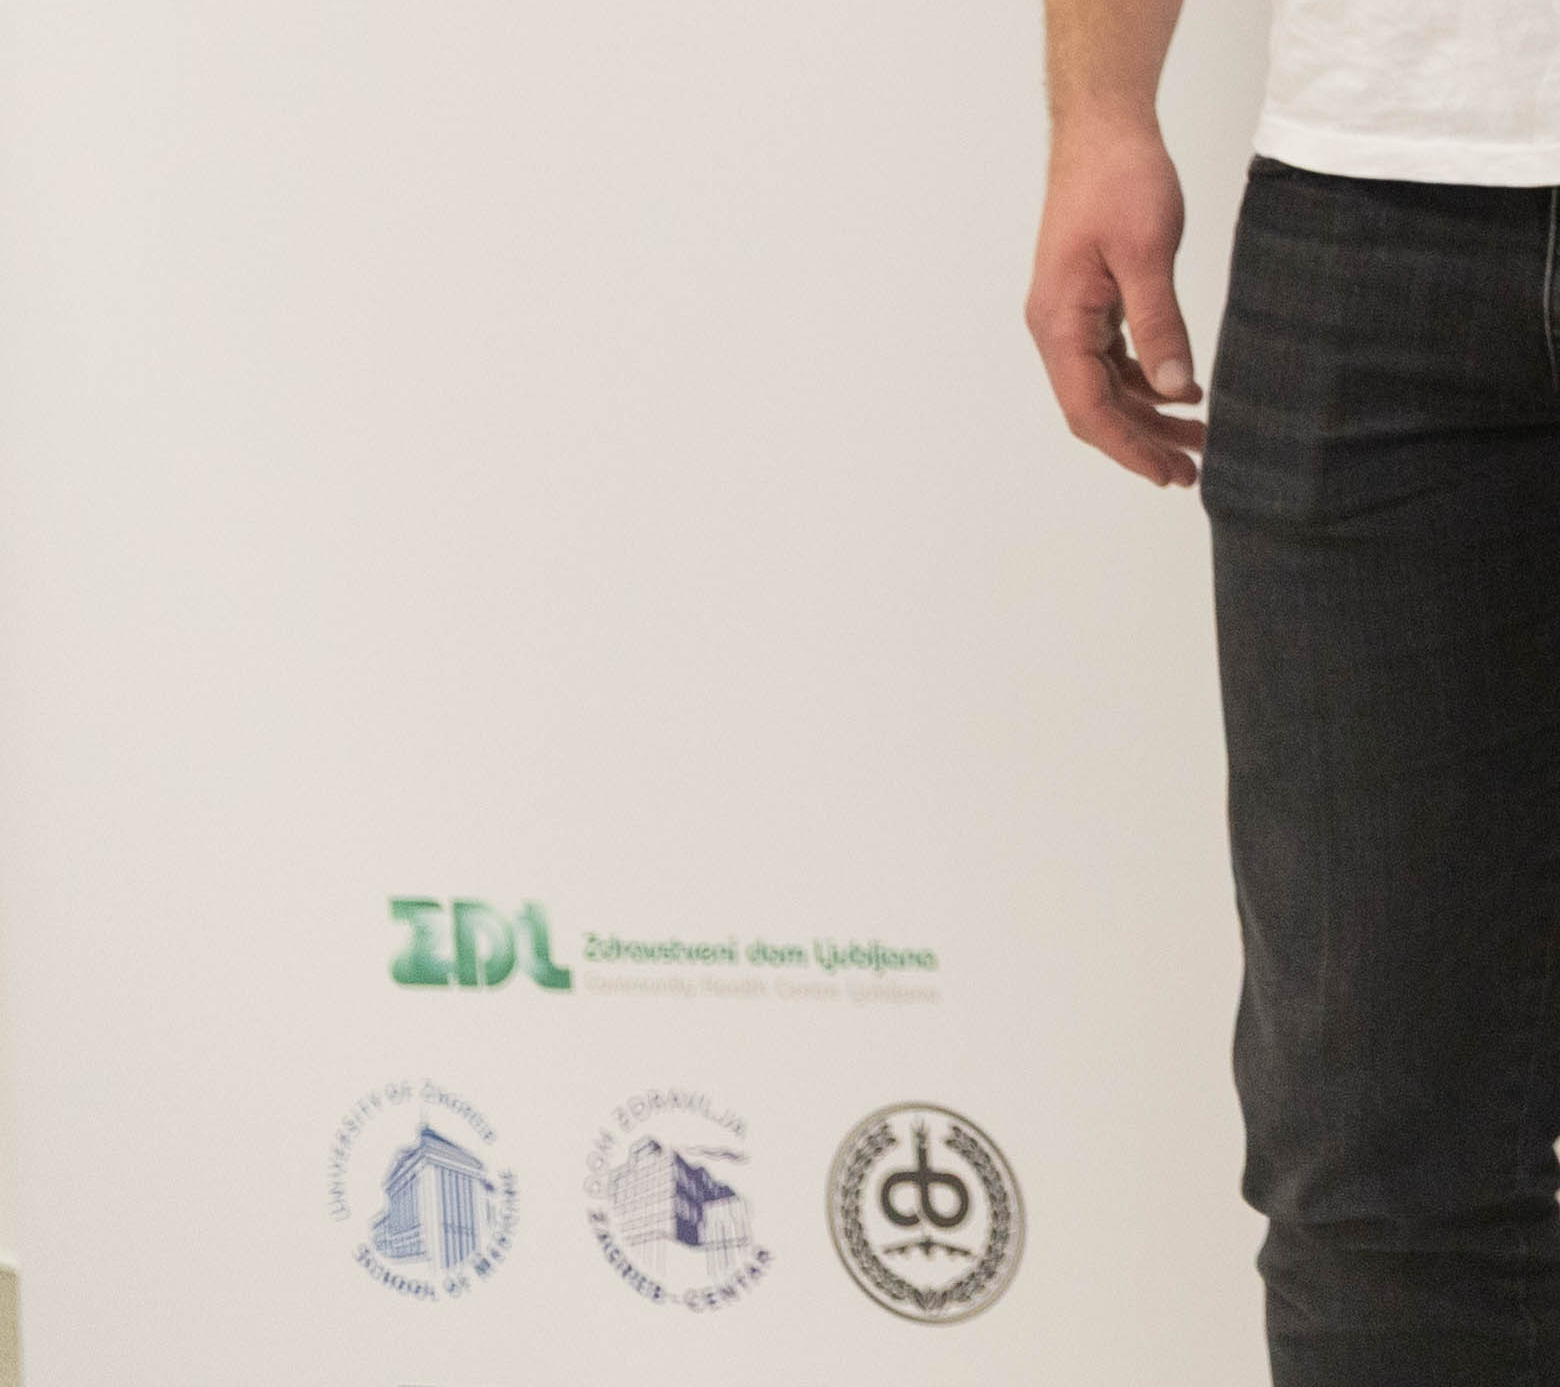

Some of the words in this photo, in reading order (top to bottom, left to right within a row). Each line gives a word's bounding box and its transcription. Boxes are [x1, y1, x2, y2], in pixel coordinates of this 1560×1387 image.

[583, 932, 738, 965] Zdravstveni
[747, 935, 802, 967] dom
[812, 937, 938, 975] Ljubljana
